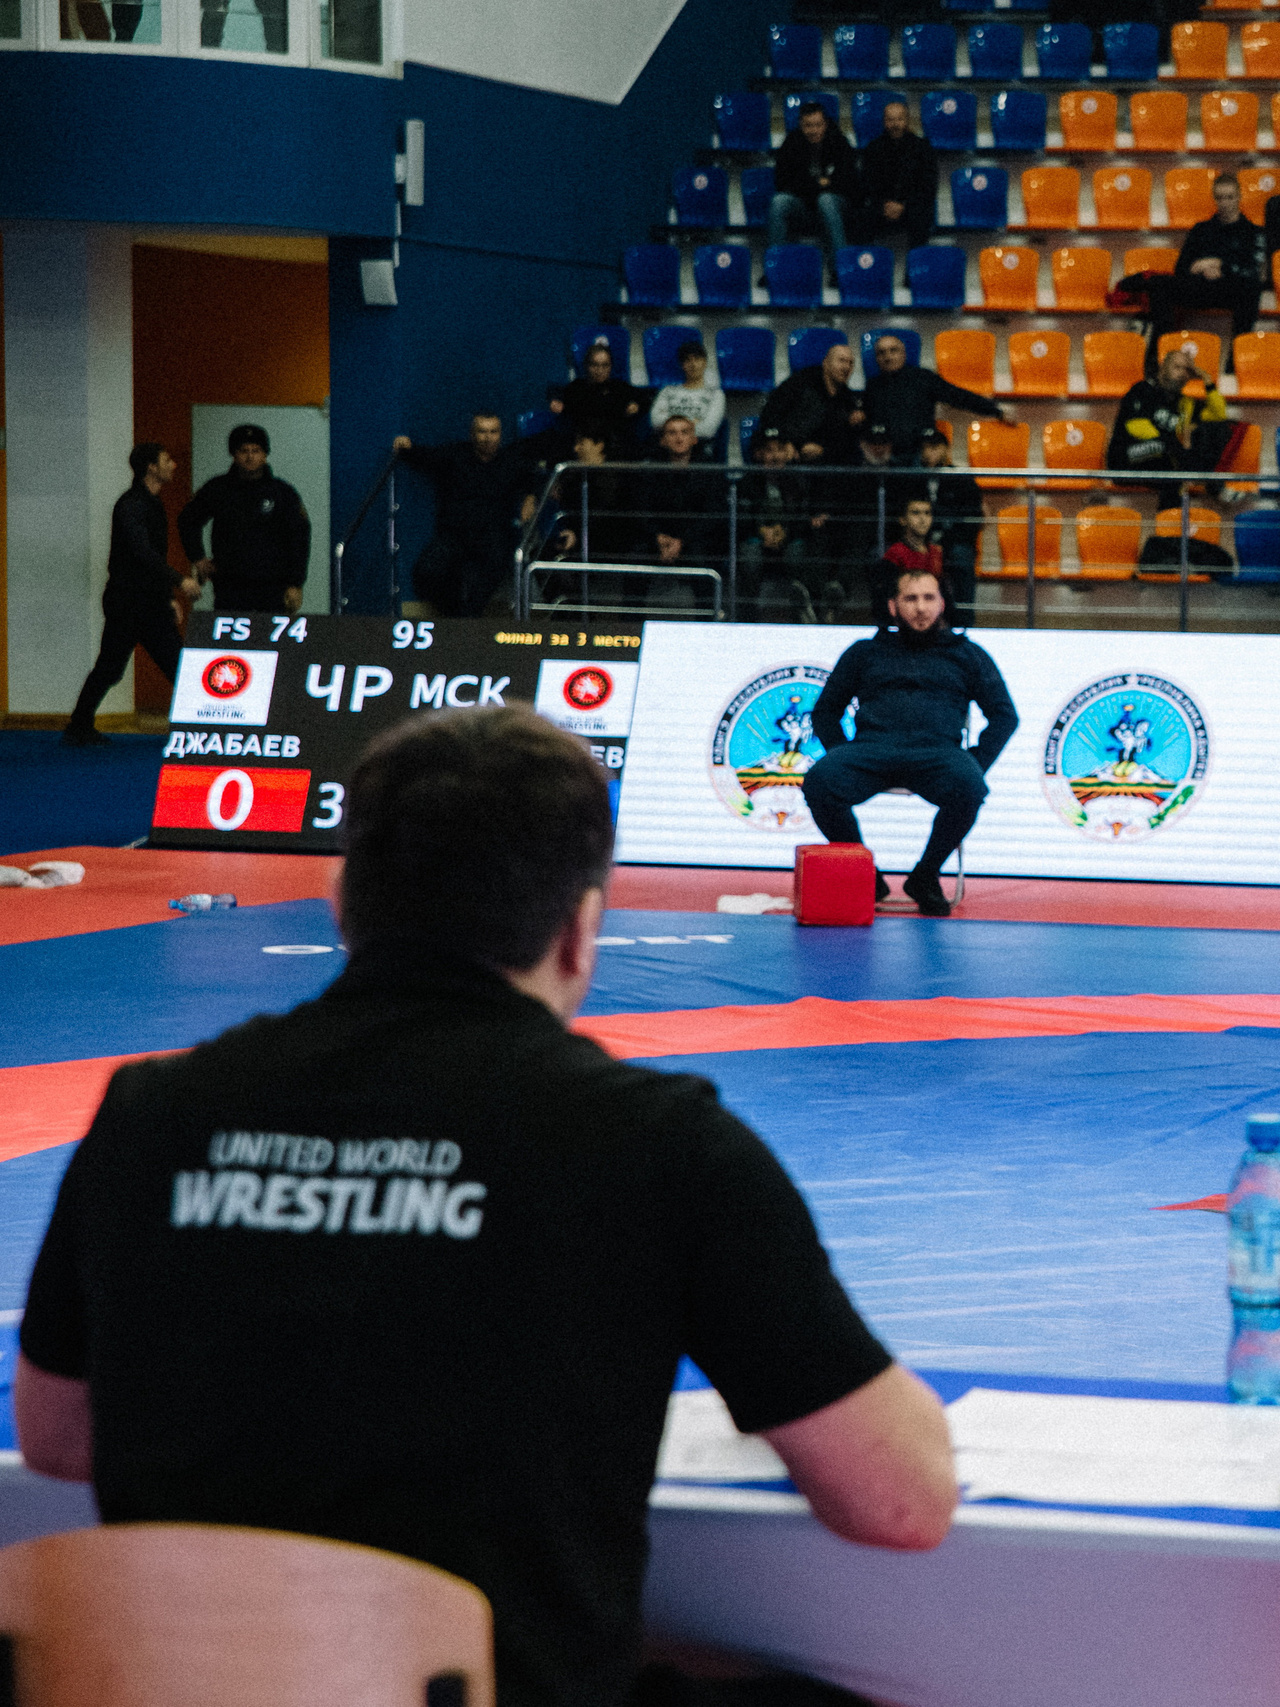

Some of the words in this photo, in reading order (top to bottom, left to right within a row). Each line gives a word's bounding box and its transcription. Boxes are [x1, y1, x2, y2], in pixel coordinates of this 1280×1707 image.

[212, 616, 251, 641] FS
[269, 615, 308, 643] 74
[392, 620, 435, 649] 95
[494, 631, 543, 645] Финал
[550, 633, 569, 646] за
[576, 632, 587, 646] 3
[592, 635, 641, 647] место
[305, 663, 394, 713] ЧР
[409, 673, 511, 709] МСК
[162, 731, 301, 759] ДЖАБАЕВ
[206, 768, 255, 832] 0
[312, 781, 346, 829] 3
[208, 1131, 335, 1173] UNITED
[336, 1138, 463, 1175] WORLD
[171, 1170, 488, 1239] WRESTLING
